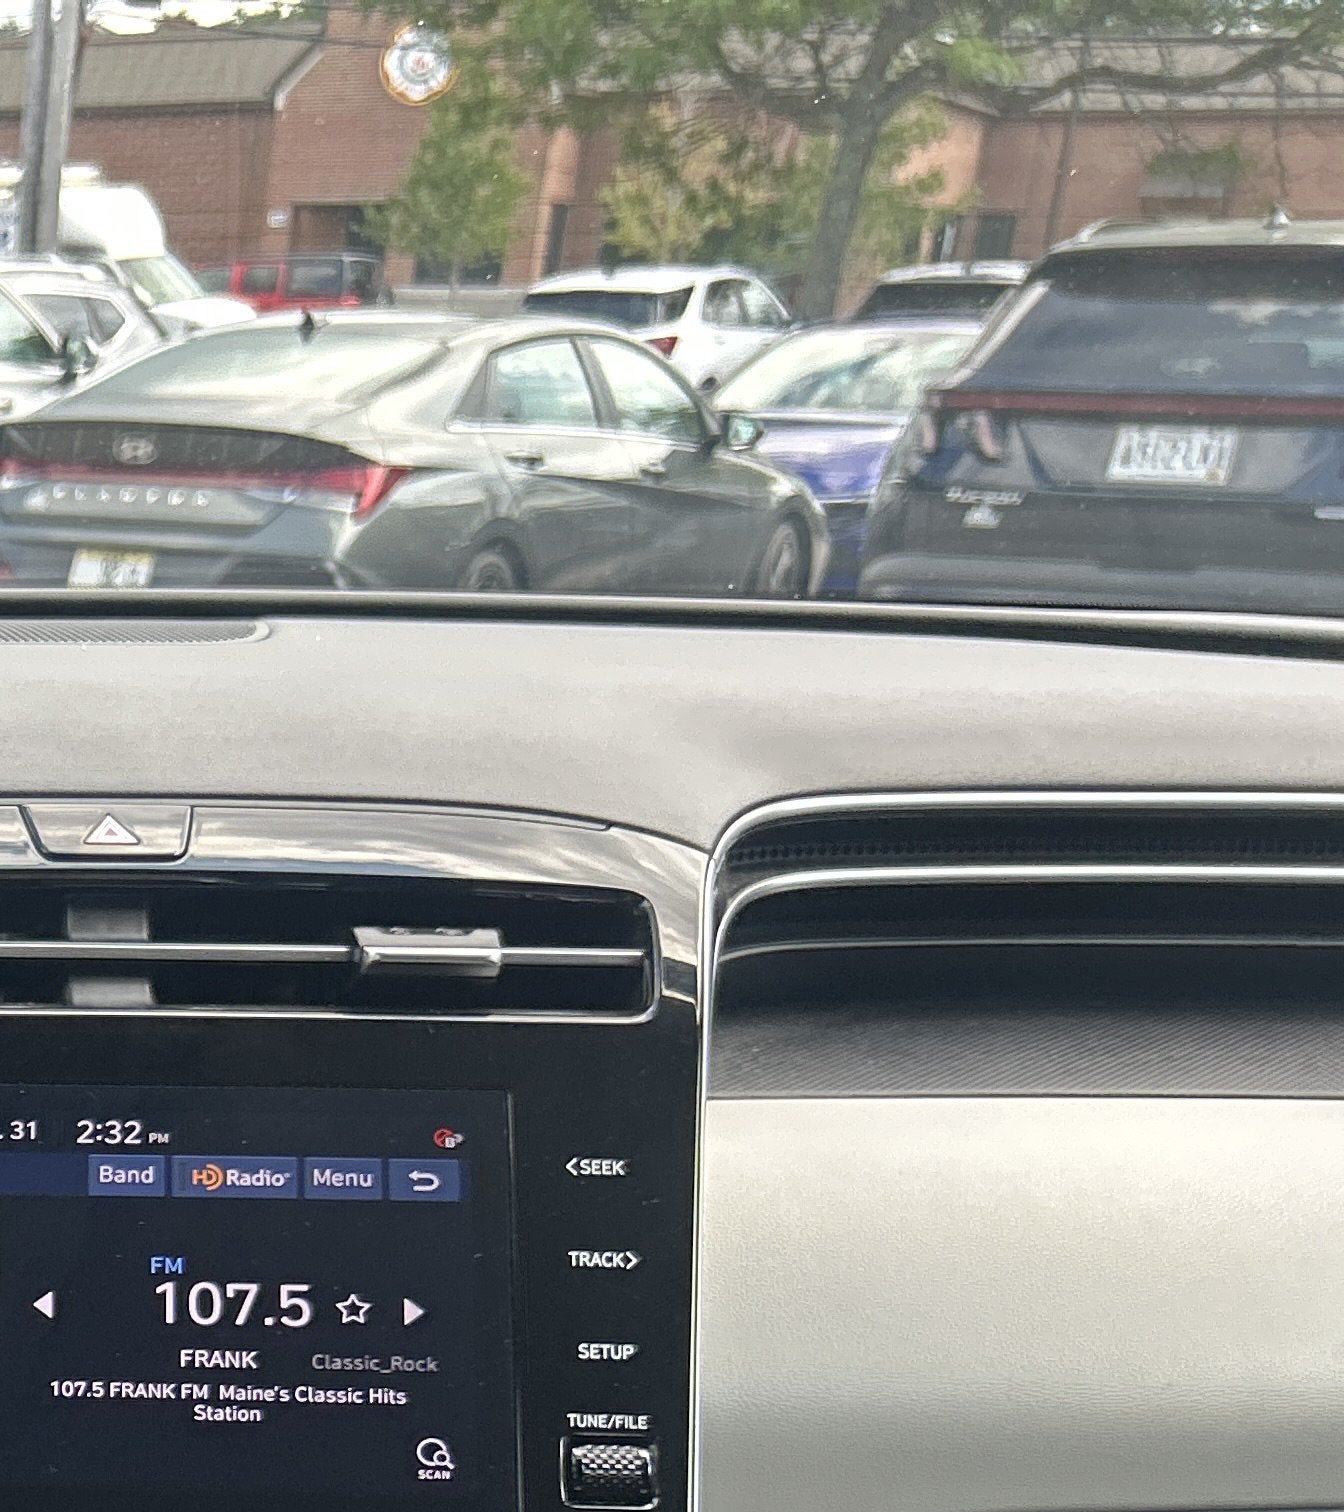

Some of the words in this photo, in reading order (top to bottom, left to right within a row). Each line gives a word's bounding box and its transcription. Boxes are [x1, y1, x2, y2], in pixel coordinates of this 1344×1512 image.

[10, 1120, 38, 1140] 31
[76, 1119, 143, 1144] 2:32
[148, 1132, 169, 1144] PM
[99, 1166, 154, 1184] Band
[580, 1159, 625, 1176] SEEK
[313, 1169, 373, 1187] Menu
[150, 1256, 184, 1274] FM
[568, 1251, 624, 1268] TRACK
[154, 1281, 312, 1327] 107.5
[179, 1350, 258, 1369] FRANK
[578, 1343, 634, 1360] SETUP
[311, 1355, 440, 1374] Classic_Rock
[50, 1381, 104, 1398] 107.5
[109, 1382, 176, 1399] FRANK
[180, 1383, 209, 1400] FM
[219, 1385, 290, 1402] Maine's
[294, 1386, 363, 1404] Classic
[369, 1388, 407, 1405] Hits
[193, 1405, 261, 1422] Station
[567, 1414, 648, 1430] TUNE/FILE
[417, 1469, 451, 1480] SCAN
